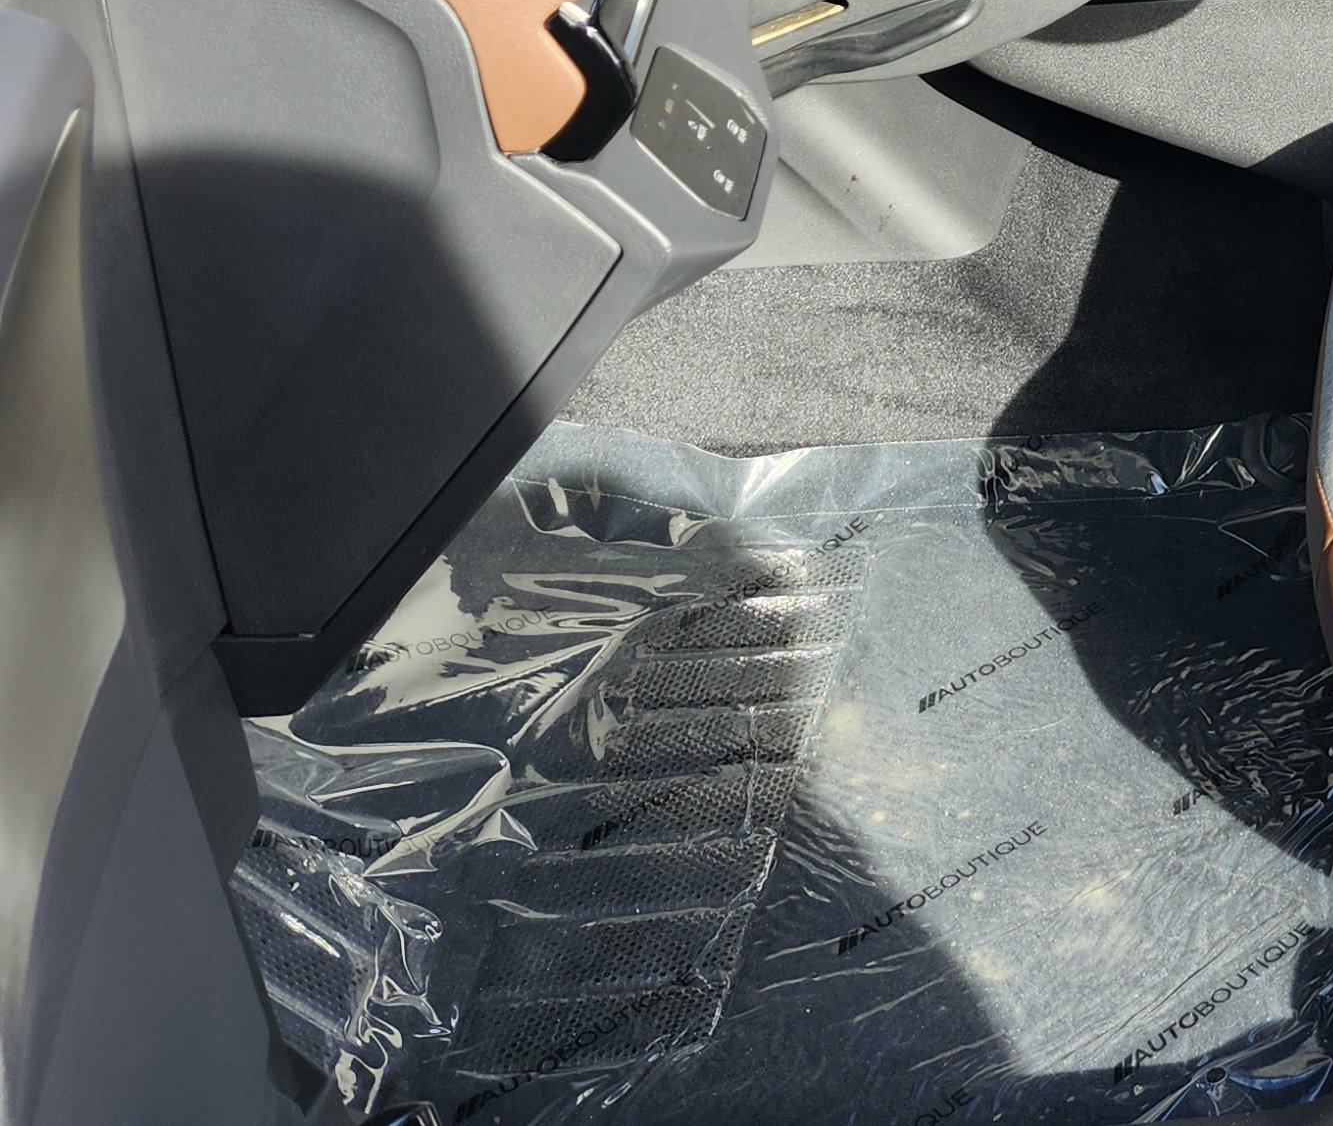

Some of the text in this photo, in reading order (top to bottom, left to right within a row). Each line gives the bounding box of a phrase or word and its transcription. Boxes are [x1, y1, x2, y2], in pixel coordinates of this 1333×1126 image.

[366, 606, 562, 666] ATOBOUTIQUE
[937, 601, 1105, 703] AUTOBOUTIQUE
[860, 820, 1049, 941] AUTOBOUTIQUE
[484, 965, 700, 1101] AUTOBOUTIQE
[1134, 920, 1316, 1069] AUTOBOUTIQUE
